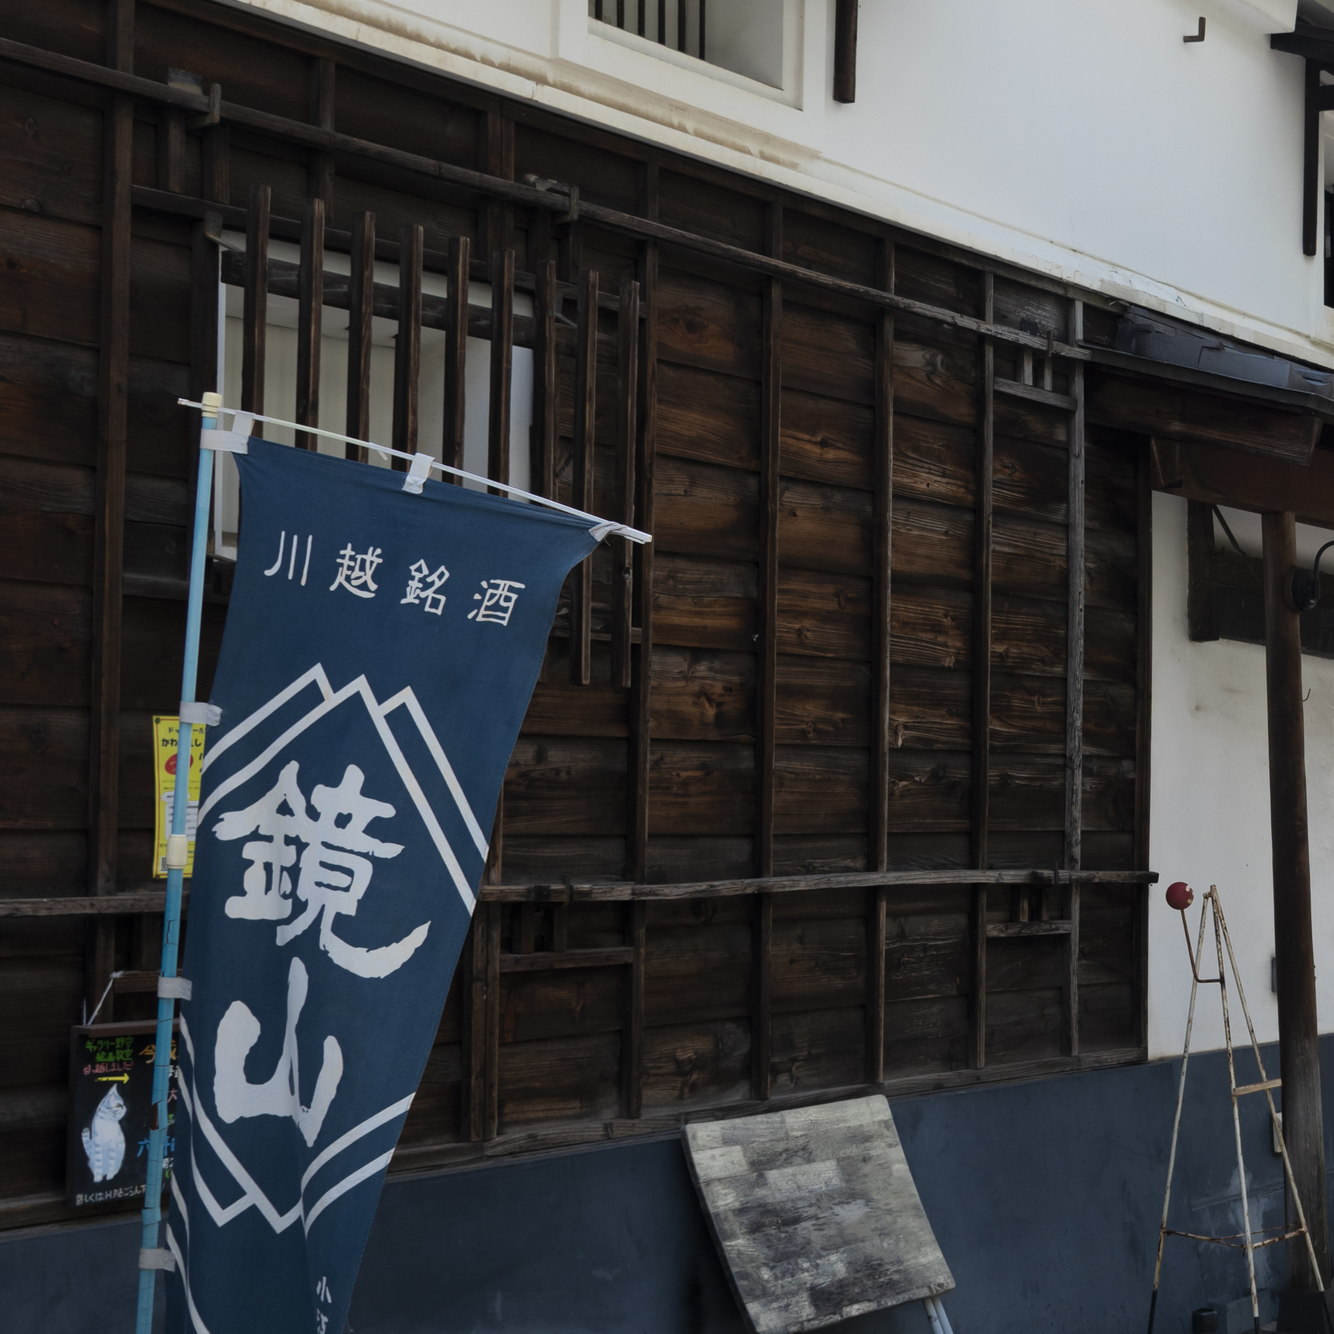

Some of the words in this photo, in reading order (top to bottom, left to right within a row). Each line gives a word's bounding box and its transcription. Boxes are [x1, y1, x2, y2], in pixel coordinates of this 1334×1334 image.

[264, 530, 526, 626] 川越銘酒
[211, 759, 432, 1148] 鏡山
